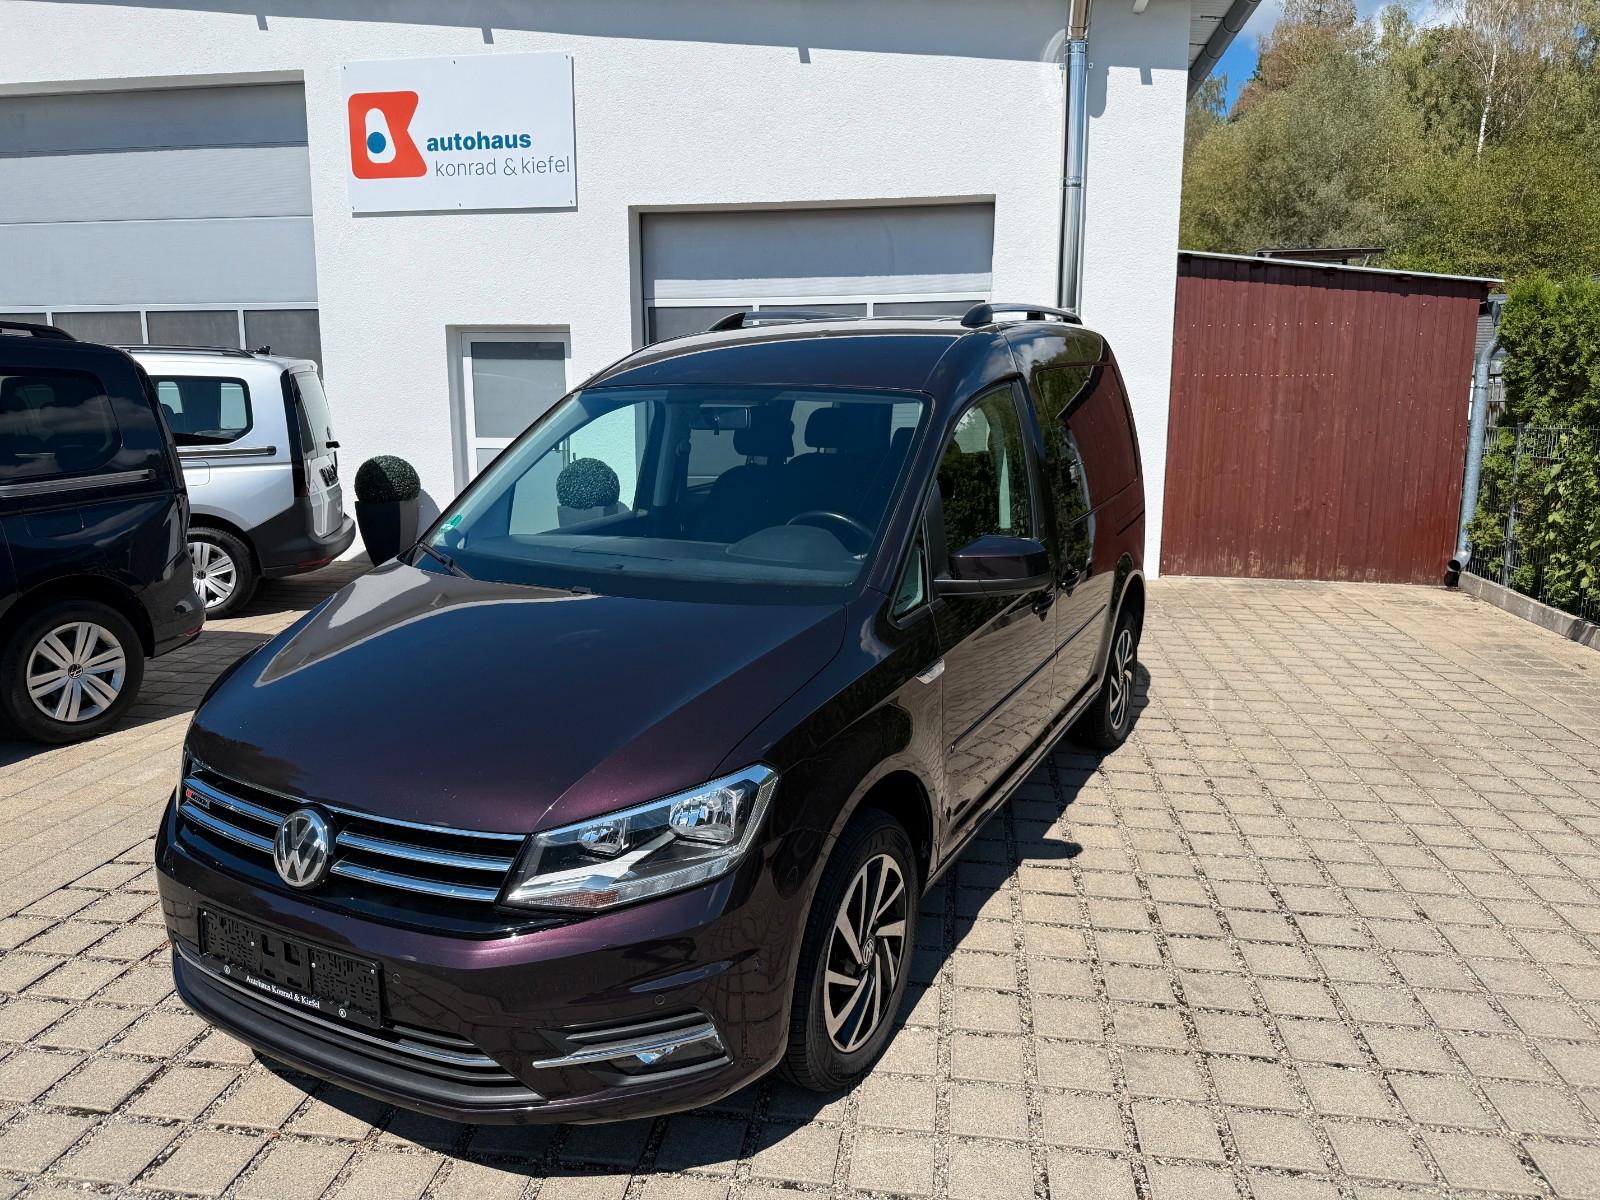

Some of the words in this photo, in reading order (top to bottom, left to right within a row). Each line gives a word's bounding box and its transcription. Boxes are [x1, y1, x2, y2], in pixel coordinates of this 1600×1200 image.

[427, 131, 531, 151] autohaus
[435, 159, 496, 176] konrad
[503, 158, 518, 176] &
[521, 155, 570, 173] kiefel
[271, 985, 294, 1000] Konrad
[294, 994, 300, 1002] &
[301, 996, 320, 1008] Kiefel
